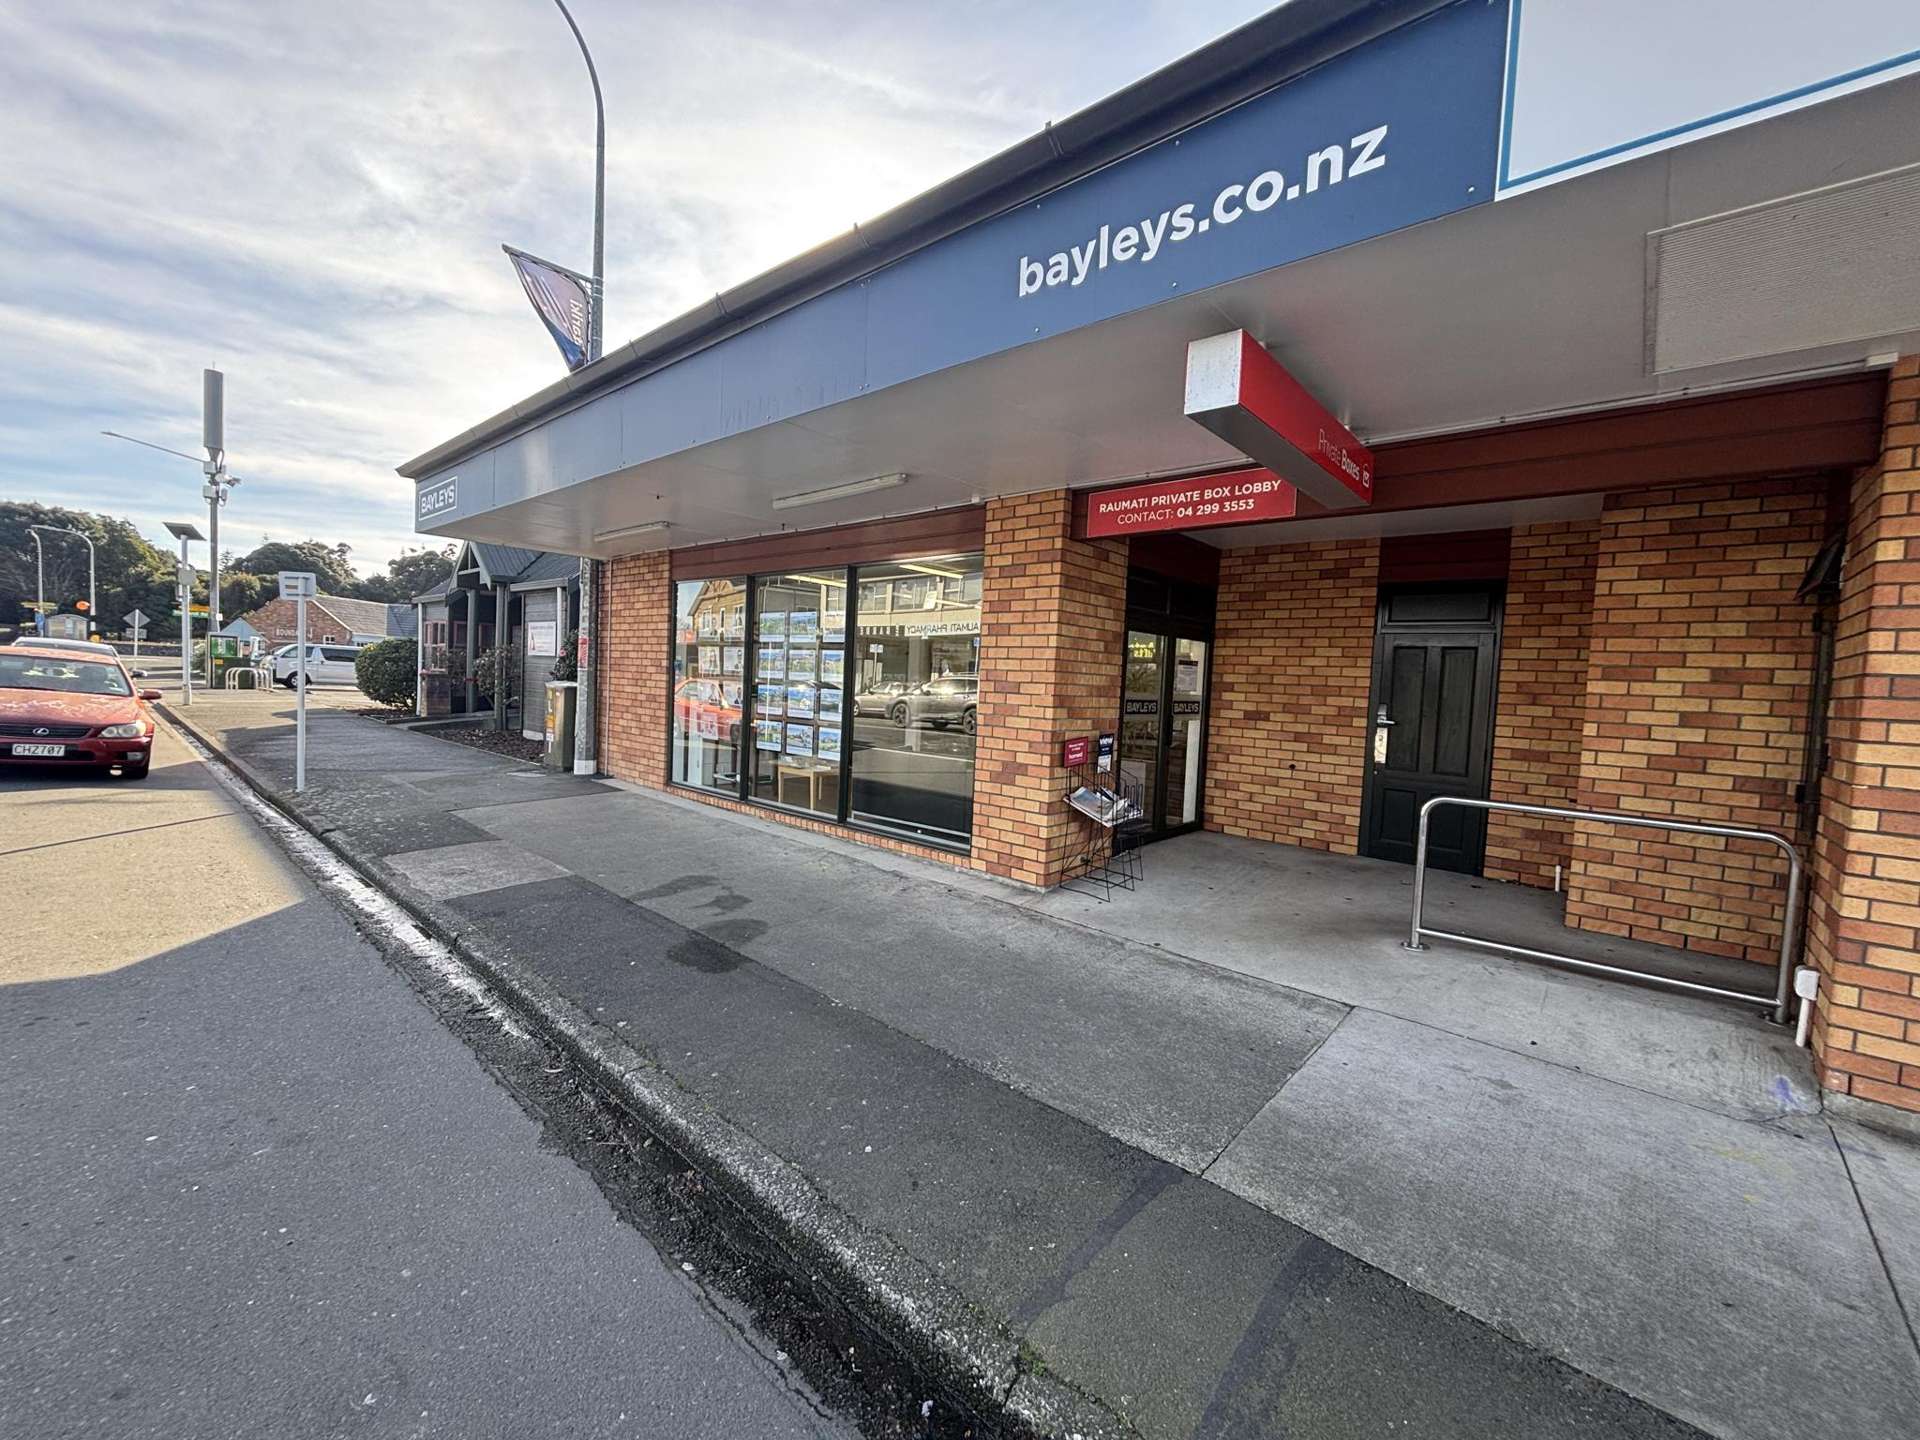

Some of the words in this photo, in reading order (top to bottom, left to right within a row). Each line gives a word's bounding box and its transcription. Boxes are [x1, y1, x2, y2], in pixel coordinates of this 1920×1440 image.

[1018, 124, 1388, 296] bayleys.co.nz
[1318, 428, 1341, 466] Private
[1341, 448, 1360, 480] Boxes
[421, 485, 454, 513] BAYLEYS
[1099, 498, 1148, 513] RAUMATI
[1151, 490, 1200, 506] PRIVATE
[1204, 486, 1231, 500] BOX
[1235, 479, 1281, 496] LOBBY
[1117, 508, 1174, 525] CONTACT:
[1177, 507, 1193, 518] 04
[1196, 503, 1220, 516] 299
[1223, 499, 1255, 513] 3553
[1126, 702, 1157, 713] BAYLEYS
[1173, 703, 1199, 713] BAYLEYS
